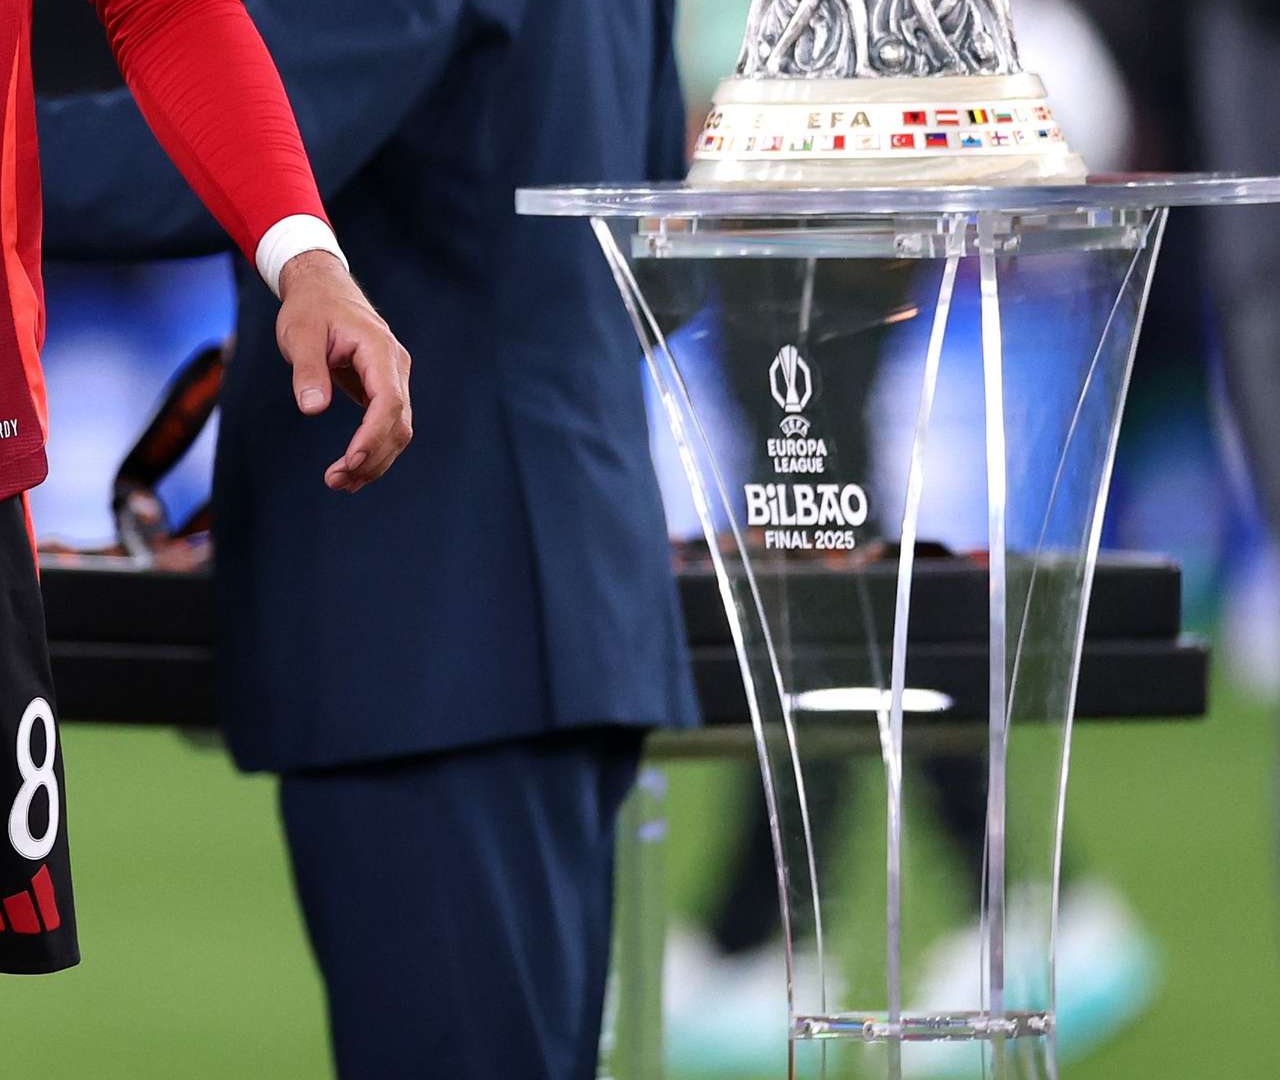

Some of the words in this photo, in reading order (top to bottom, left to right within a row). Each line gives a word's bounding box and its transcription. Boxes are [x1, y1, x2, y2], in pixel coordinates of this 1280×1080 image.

[767, 438, 828, 457] EUROPA
[774, 458, 825, 473] LEAGUE
[764, 530, 813, 549] FINAL
[815, 530, 856, 550] 2025
[7, 696, 60, 861] 8
